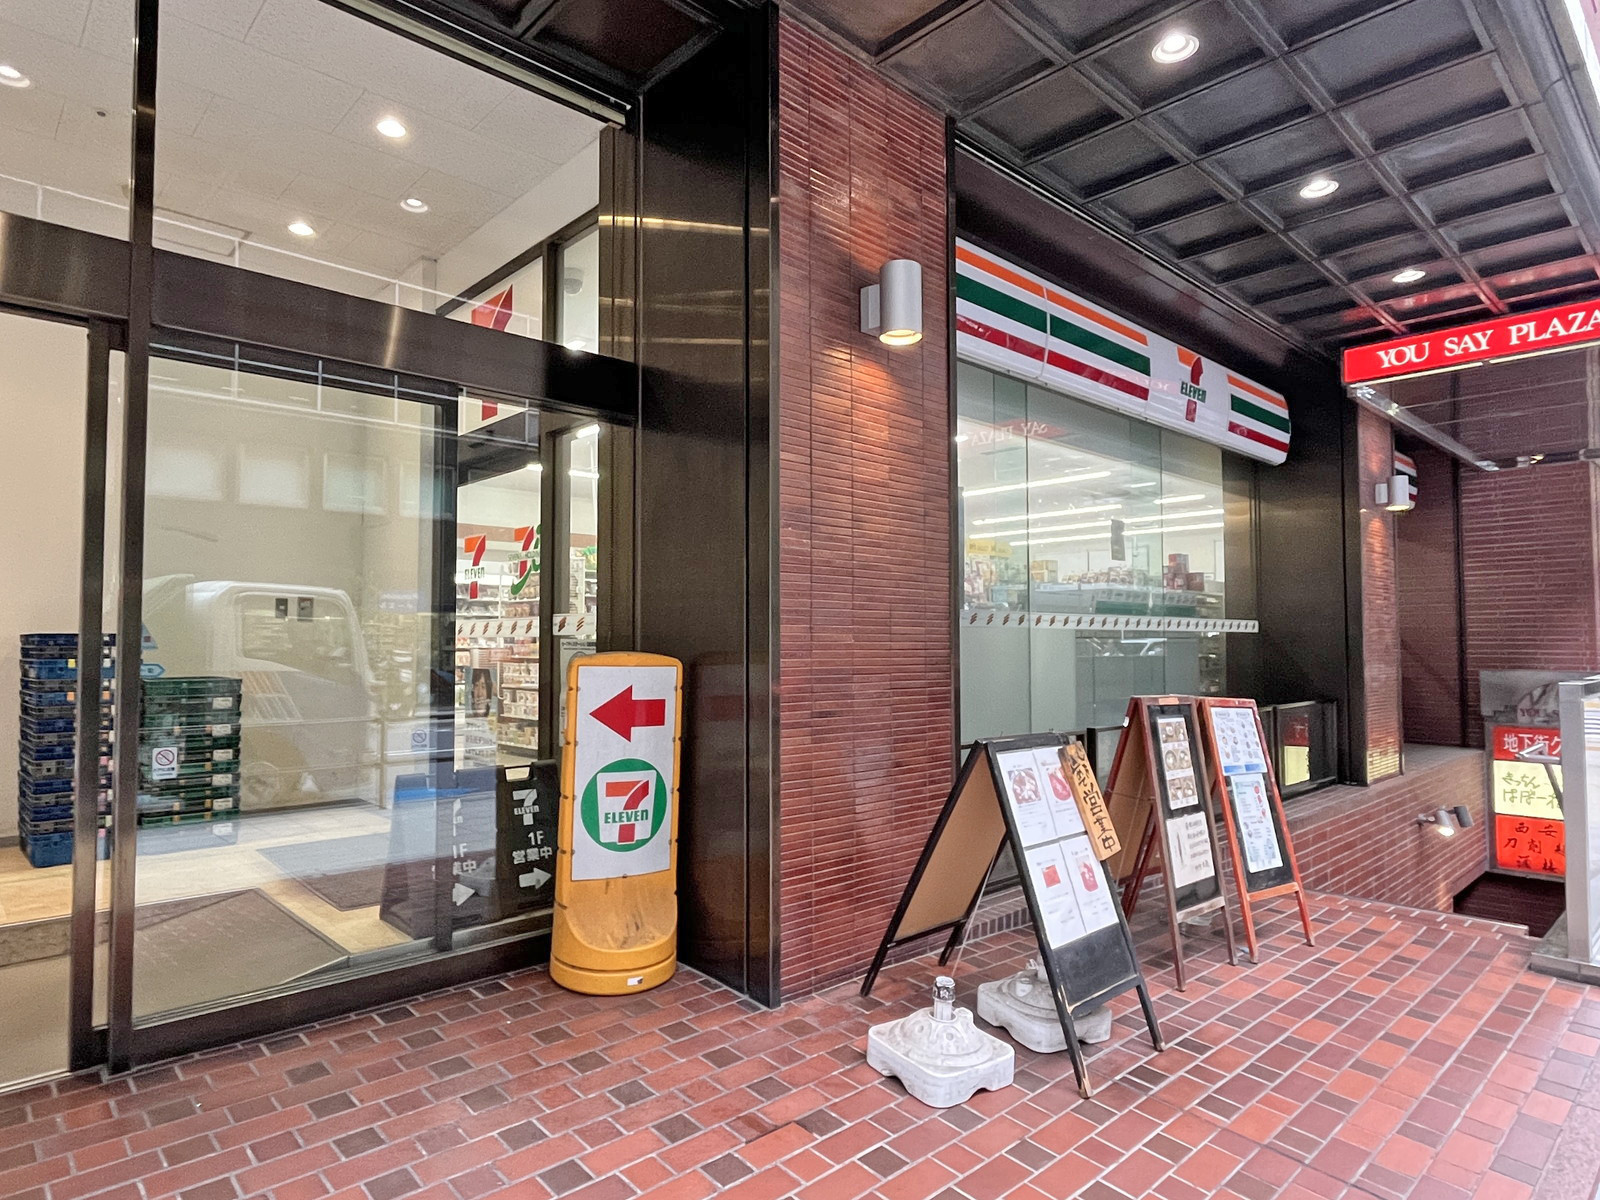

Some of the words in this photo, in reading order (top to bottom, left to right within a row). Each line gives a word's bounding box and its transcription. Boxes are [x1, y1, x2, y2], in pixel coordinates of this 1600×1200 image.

[1376, 341, 1430, 369] YOU
[1444, 330, 1494, 357] SAY
[605, 779, 650, 843] 7
[528, 830, 545, 845] 1F
[512, 846, 553, 865] 営業中
